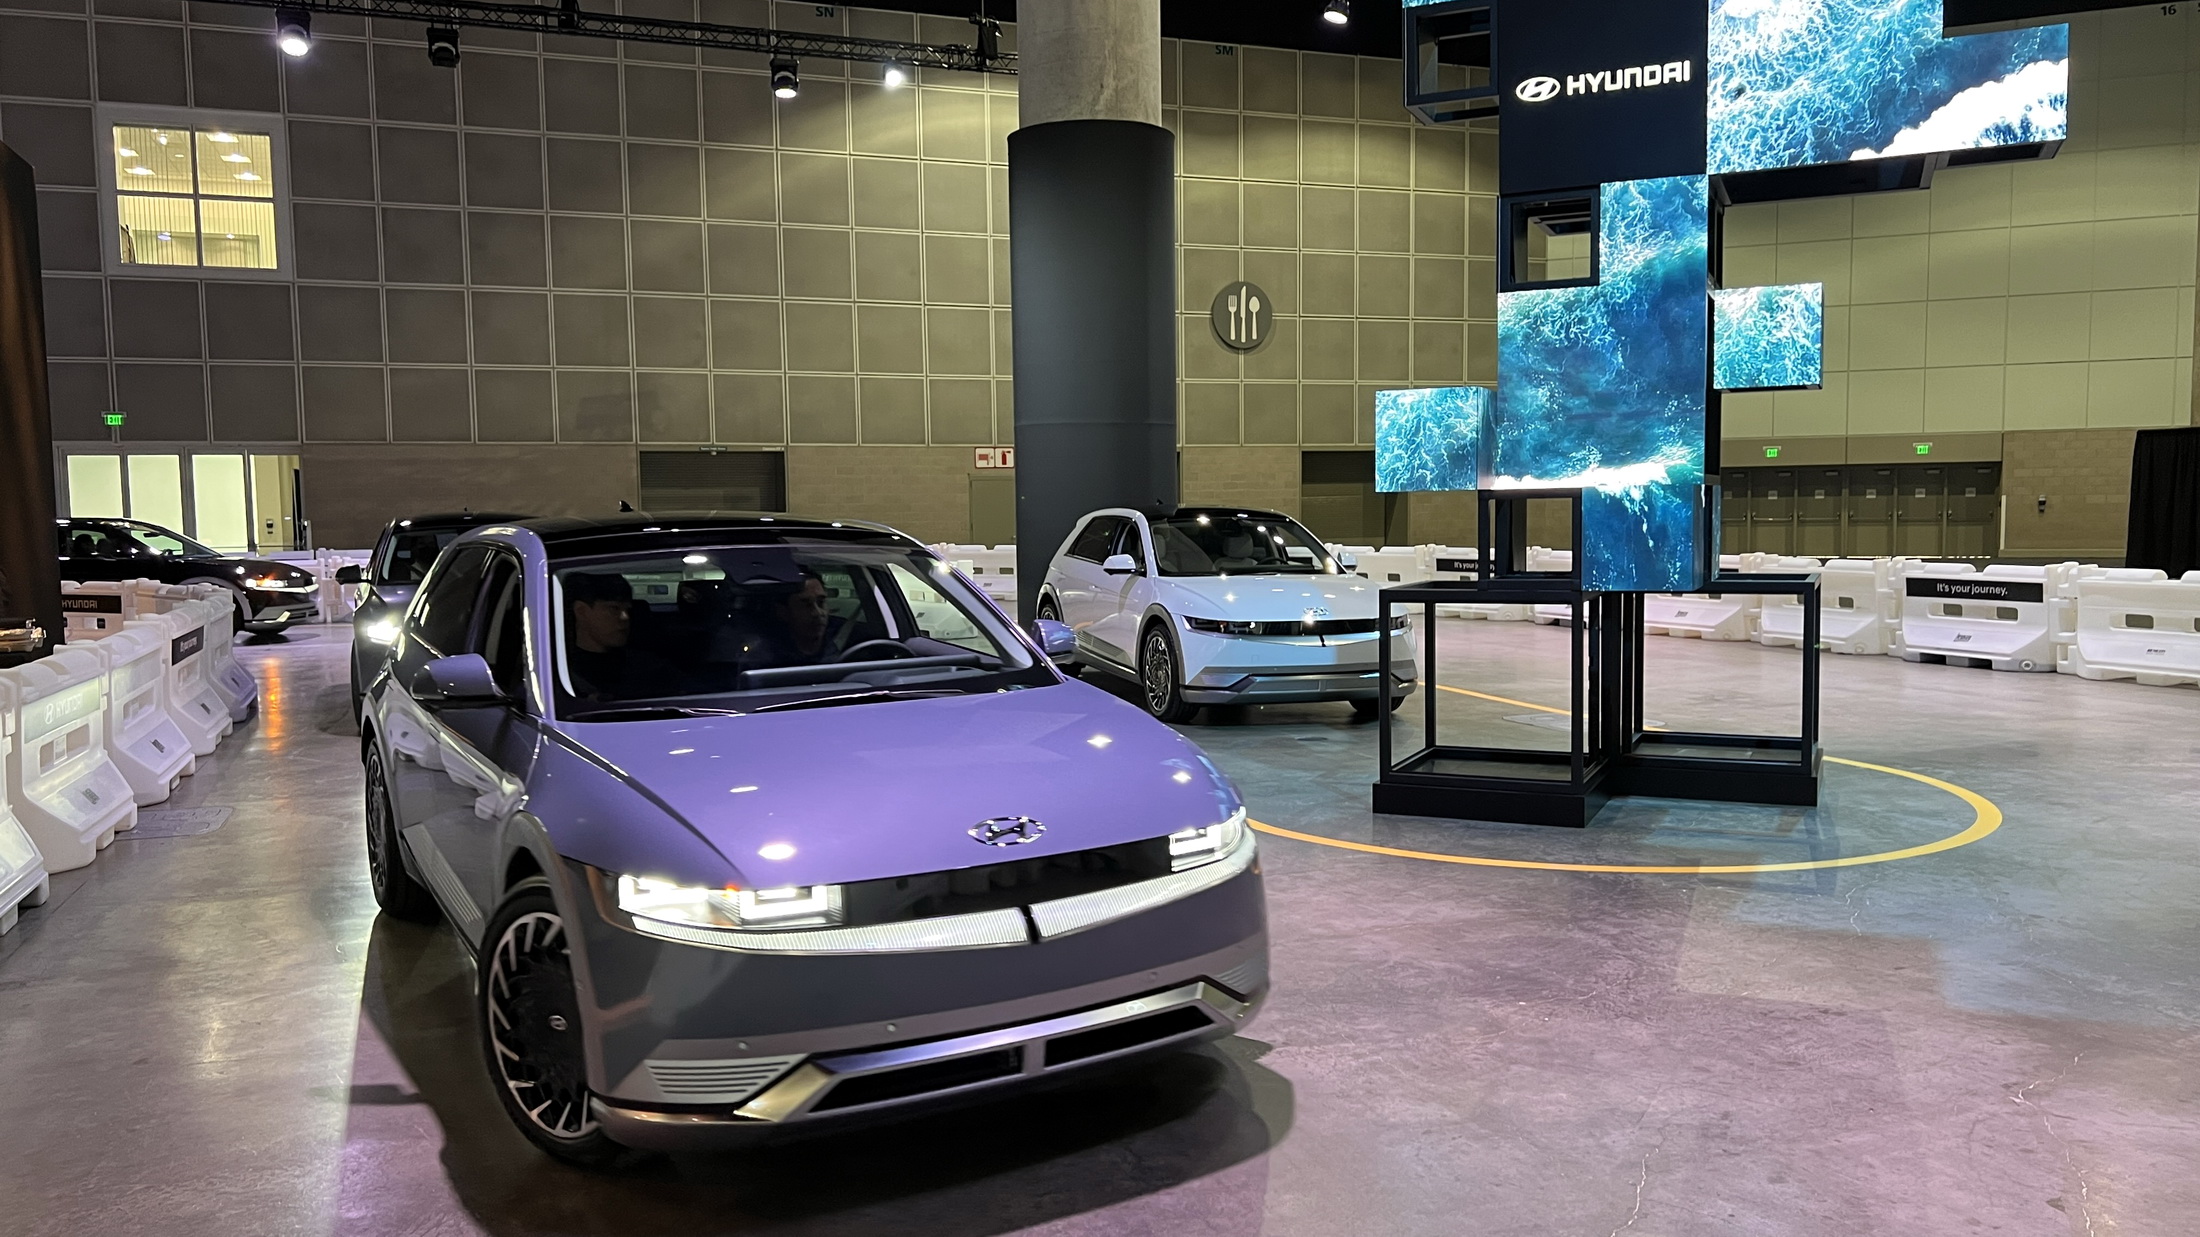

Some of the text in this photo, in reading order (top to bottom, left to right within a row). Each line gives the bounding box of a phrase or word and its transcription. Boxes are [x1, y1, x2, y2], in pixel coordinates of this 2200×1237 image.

[815, 5, 835, 18] SN
[2160, 4, 2177, 16] 16
[1215, 44, 1234, 56] SM
[1566, 60, 1691, 96] HYUNDAI
[1936, 582, 2008, 597] It's your journey.
[61, 599, 98, 609] HYUNDAI
